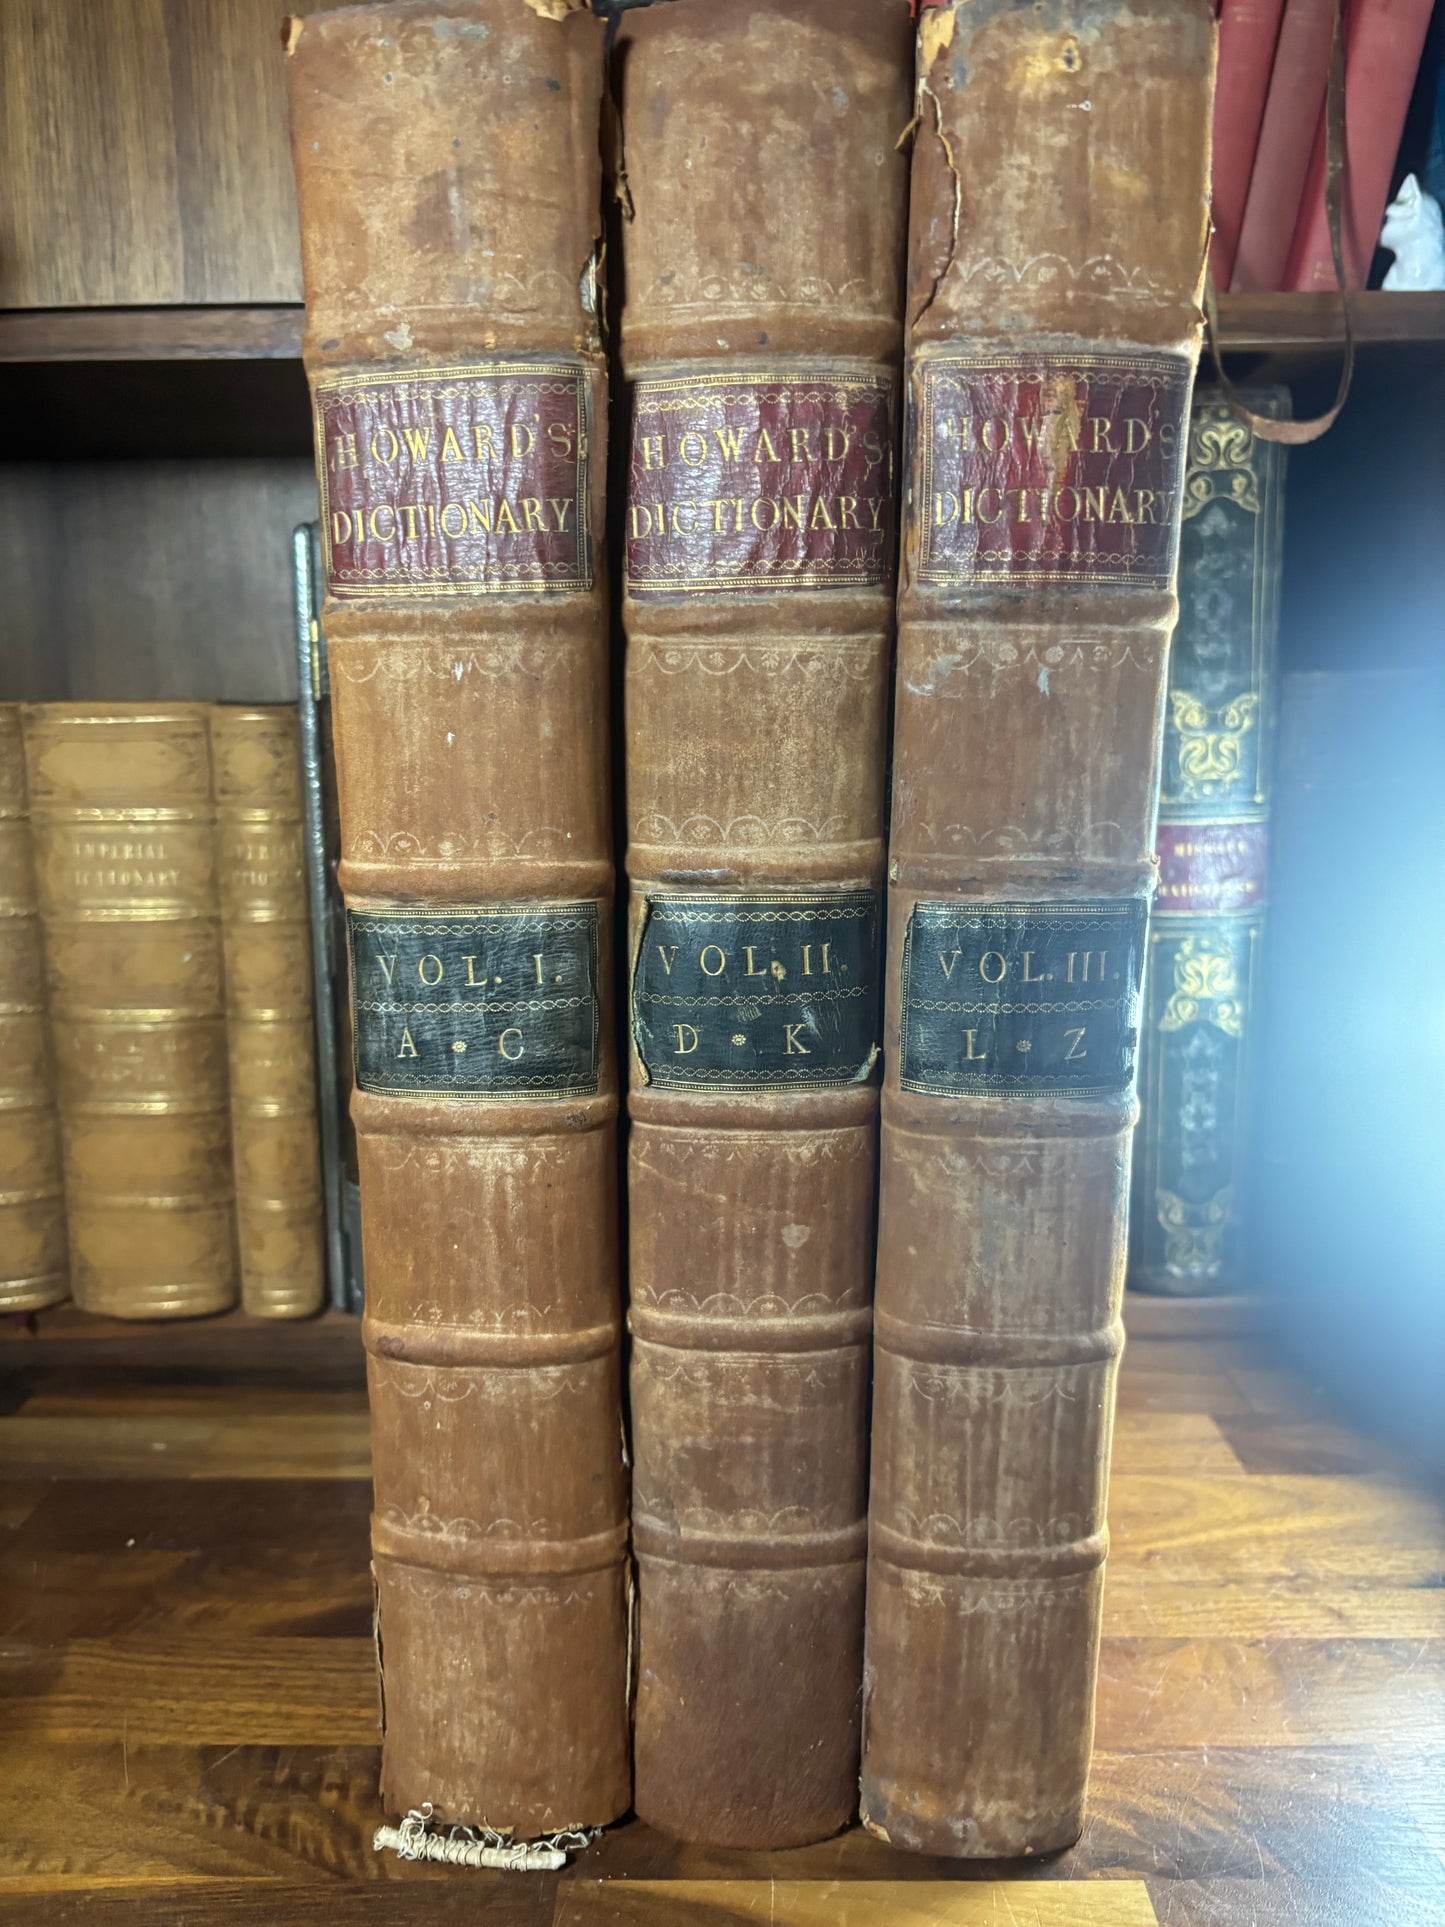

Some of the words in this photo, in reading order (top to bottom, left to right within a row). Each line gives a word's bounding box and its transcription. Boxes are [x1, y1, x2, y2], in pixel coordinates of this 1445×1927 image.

[334, 413, 572, 470] HOWARD'S
[641, 425, 883, 471] HOWARD'S
[946, 410, 1175, 459] HOWARD'S
[333, 499, 573, 544] DICTIONARY
[629, 495, 885, 540] DICTIONARY
[933, 485, 1176, 526] DICTIONARY
[64, 870, 180, 886] ICTIONARY
[376, 954, 502, 986] VOL.
[532, 954, 562, 984] I.
[656, 945, 787, 982] VOL
[800, 943, 848, 976] II.
[938, 950, 1054, 983] VOL.
[1066, 950, 1120, 983] III.
[397, 1026, 420, 1058] A
[499, 1028, 524, 1060] C
[673, 1024, 699, 1054] D
[783, 1023, 811, 1055] K
[961, 1029, 987, 1060] L
[1064, 1027, 1087, 1060] Z
